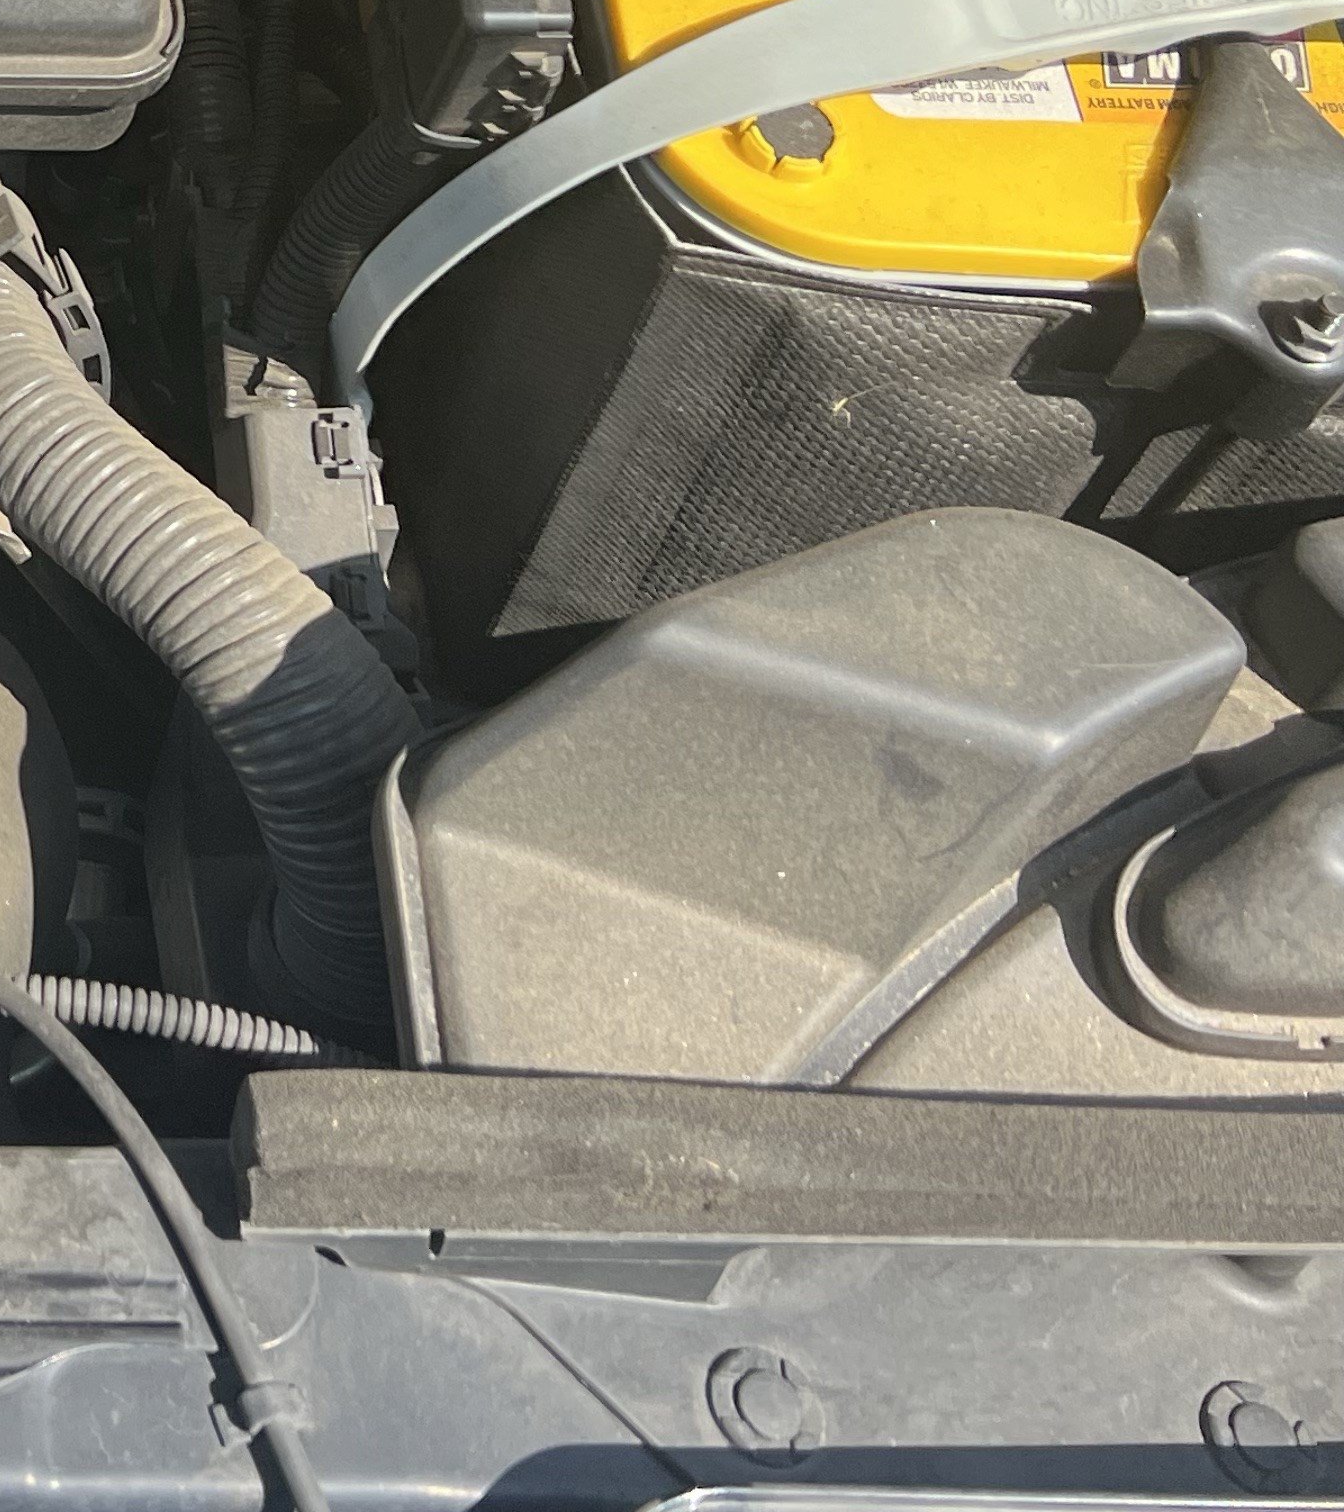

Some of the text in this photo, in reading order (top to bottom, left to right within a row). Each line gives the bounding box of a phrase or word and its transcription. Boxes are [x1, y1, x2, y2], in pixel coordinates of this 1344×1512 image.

[911, 90, 974, 103] CLARIOS
[976, 92, 997, 103] BY
[1087, 97, 1154, 110] BATTERY
